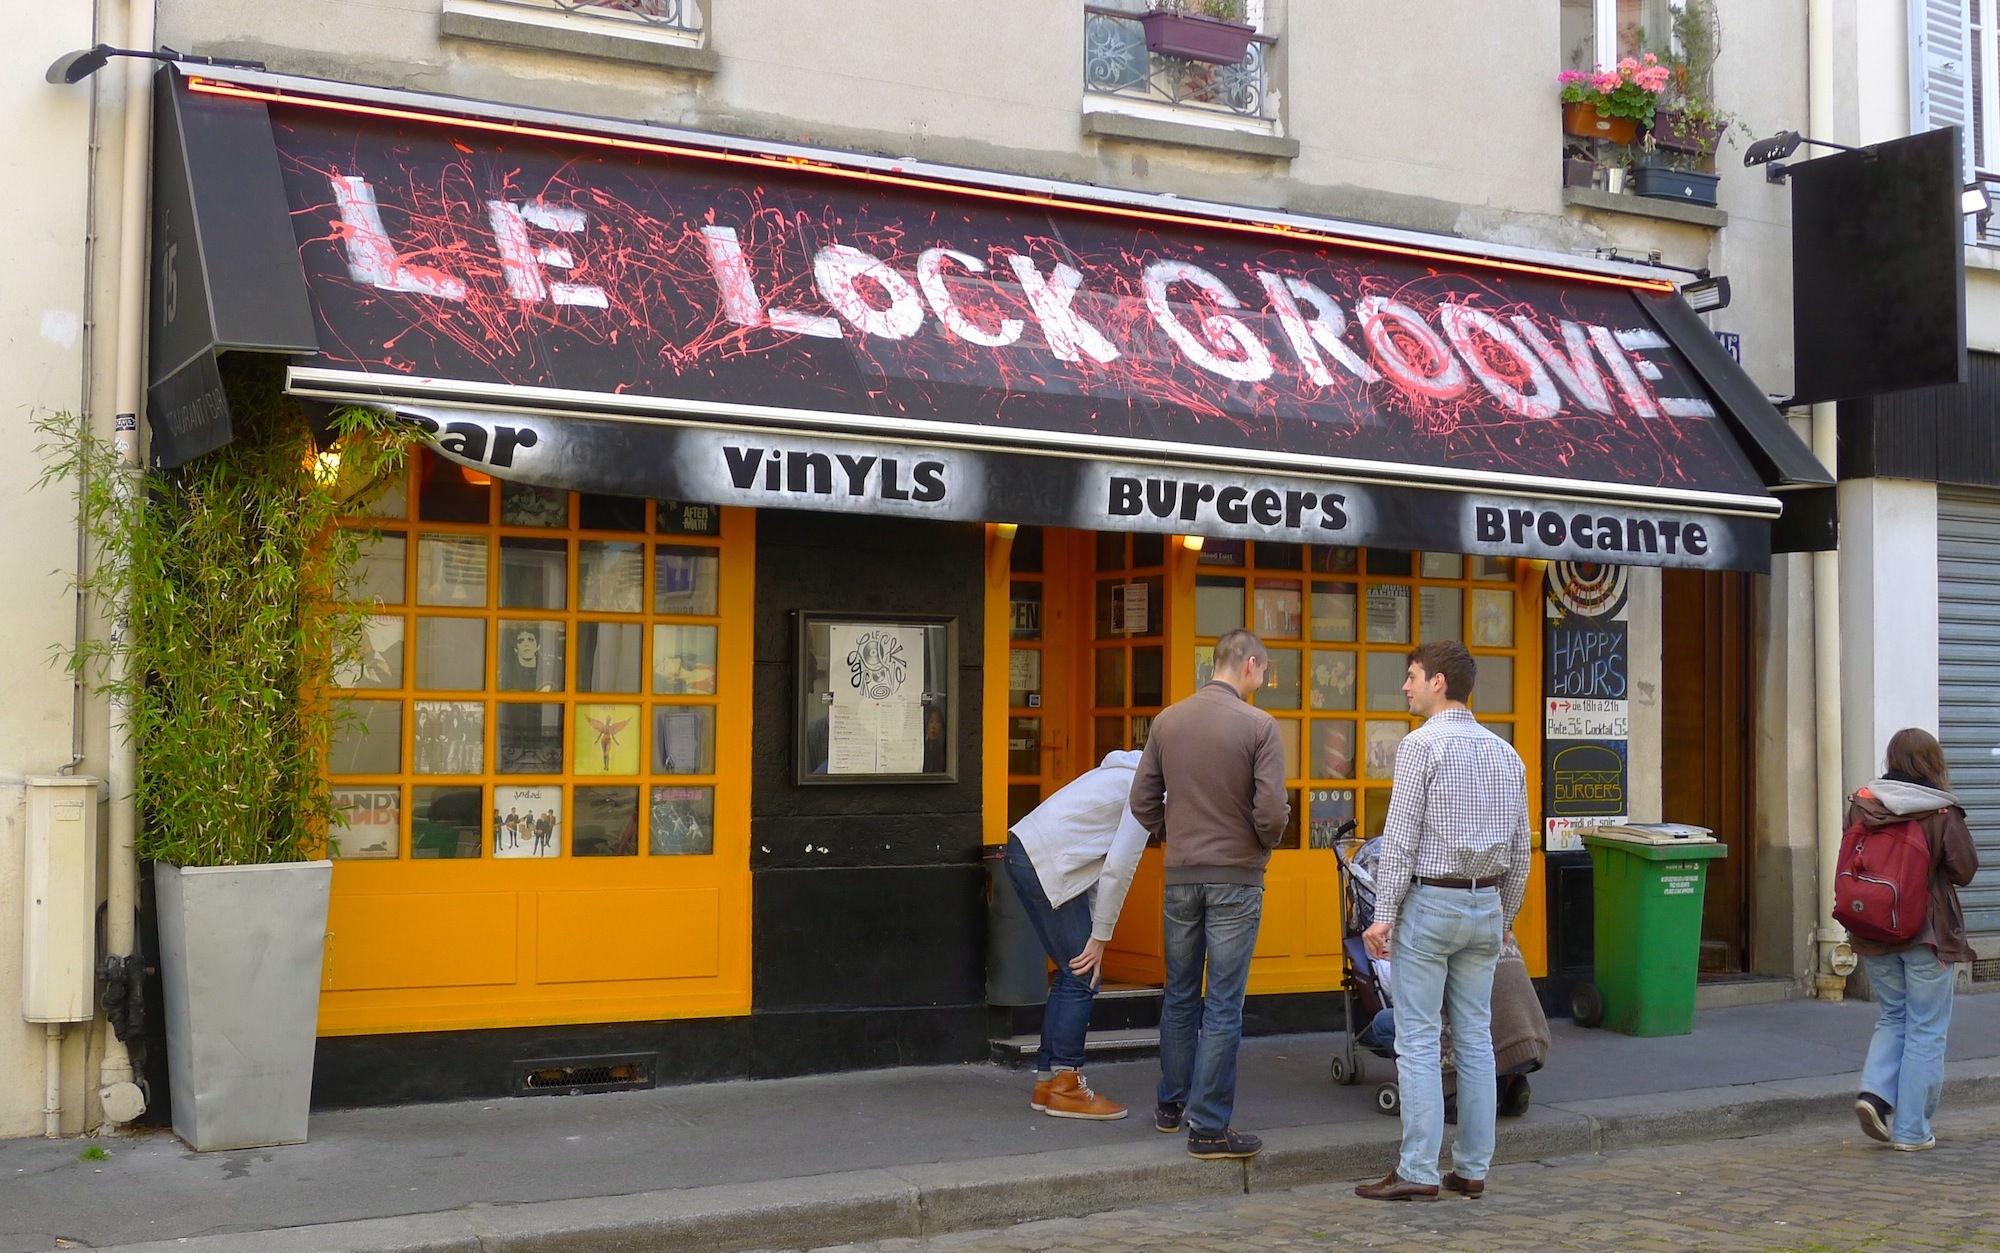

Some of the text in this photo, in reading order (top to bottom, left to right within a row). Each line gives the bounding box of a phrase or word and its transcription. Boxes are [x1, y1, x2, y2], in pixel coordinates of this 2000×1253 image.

[332, 176, 1715, 420] LE LOCK GROOVE
[1010, 602, 1039, 629] PEN
[1553, 629, 1623, 676] HAPPY
[1553, 654, 1626, 697] HOURS
[1548, 718, 1567, 735] Pinte
[1585, 719, 1613, 736] Cocktail
[1555, 783, 1622, 800] BURGERS
